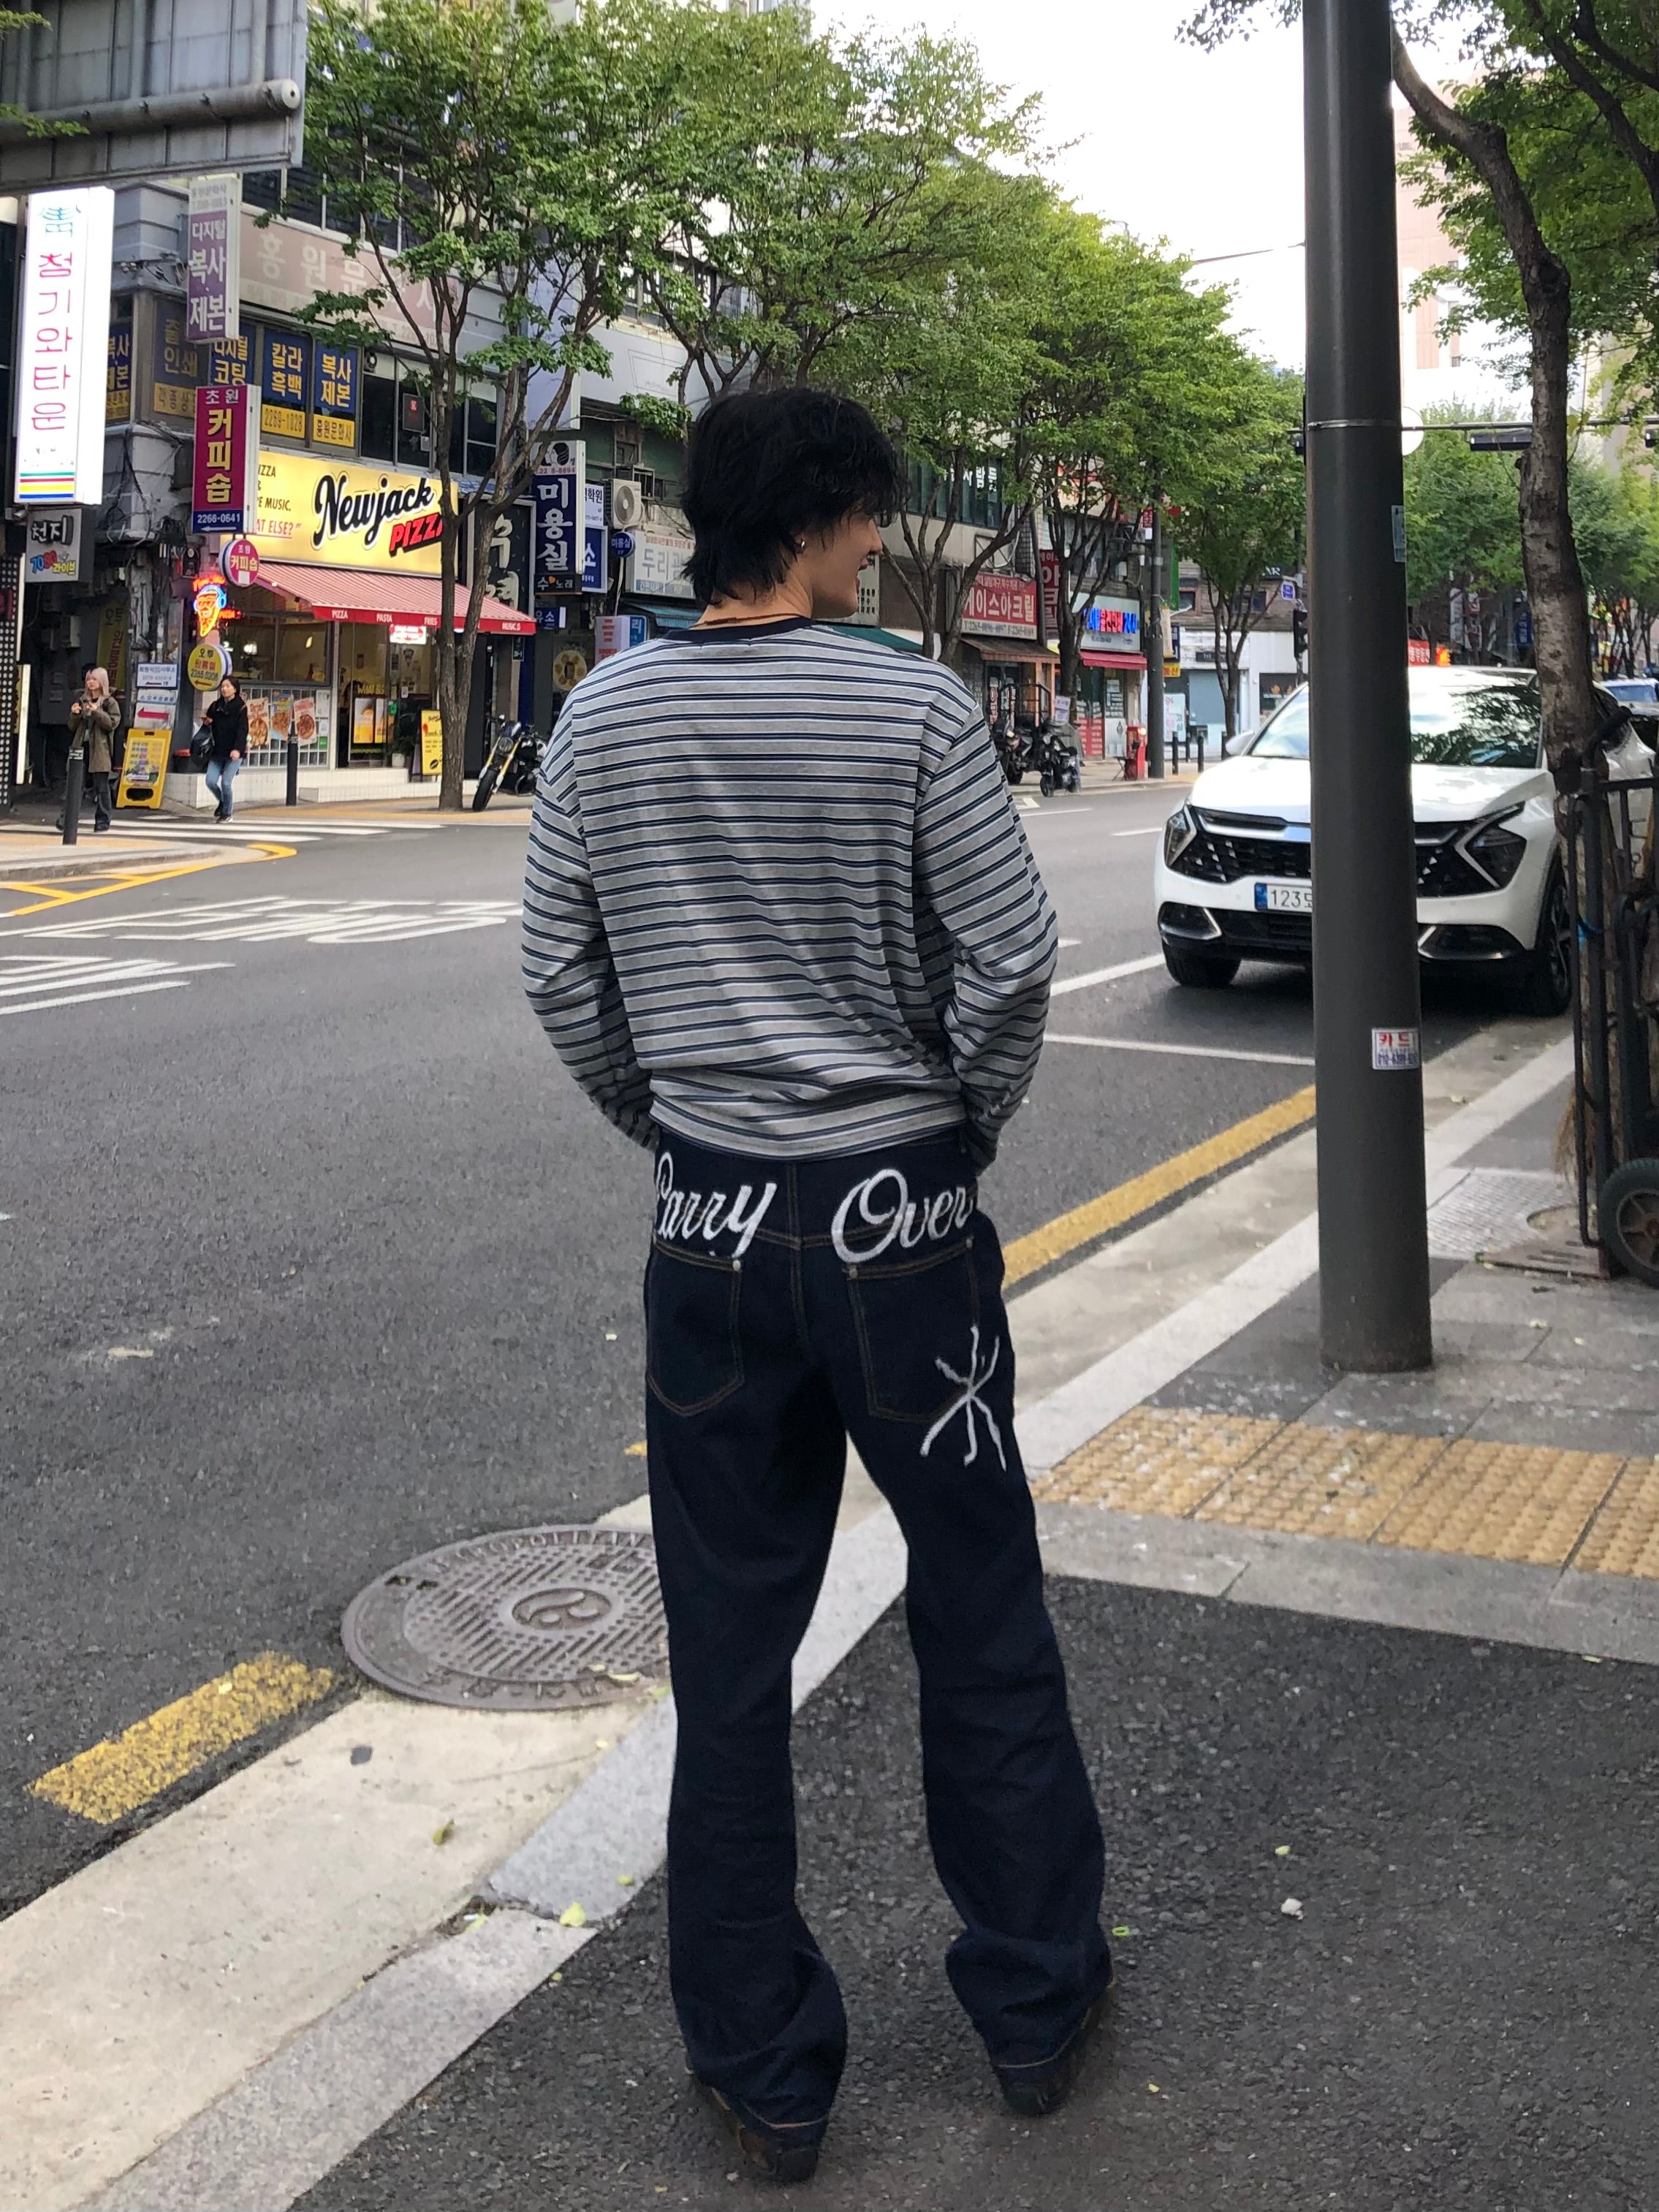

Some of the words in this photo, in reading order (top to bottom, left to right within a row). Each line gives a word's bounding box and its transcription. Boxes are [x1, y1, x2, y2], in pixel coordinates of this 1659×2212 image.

[191, 220, 226, 242] 디지털
[189, 246, 227, 284] 복사
[189, 294, 225, 332] 제본
[271, 343, 303, 372] 칼라
[322, 353, 352, 382] 복사
[214, 359, 246, 387] 코팅
[270, 370, 302, 400] 흑백
[205, 389, 239, 405] 초원
[320, 380, 351, 408] 제본
[205, 408, 233, 504] 커피숍
[258, 464, 276, 478] IZZA
[265, 498, 292, 512] MUSIC.
[313, 474, 435, 547] Newjack
[31, 516, 73, 544] 천지
[536, 477, 574, 571] 미용실
[230, 555, 258, 571] 커피숍
[555, 578, 574, 589] 노래
[331, 609, 348, 620] PIZZA
[376, 613, 393, 623] PASTA
[832, 1169, 973, 1263] Over
